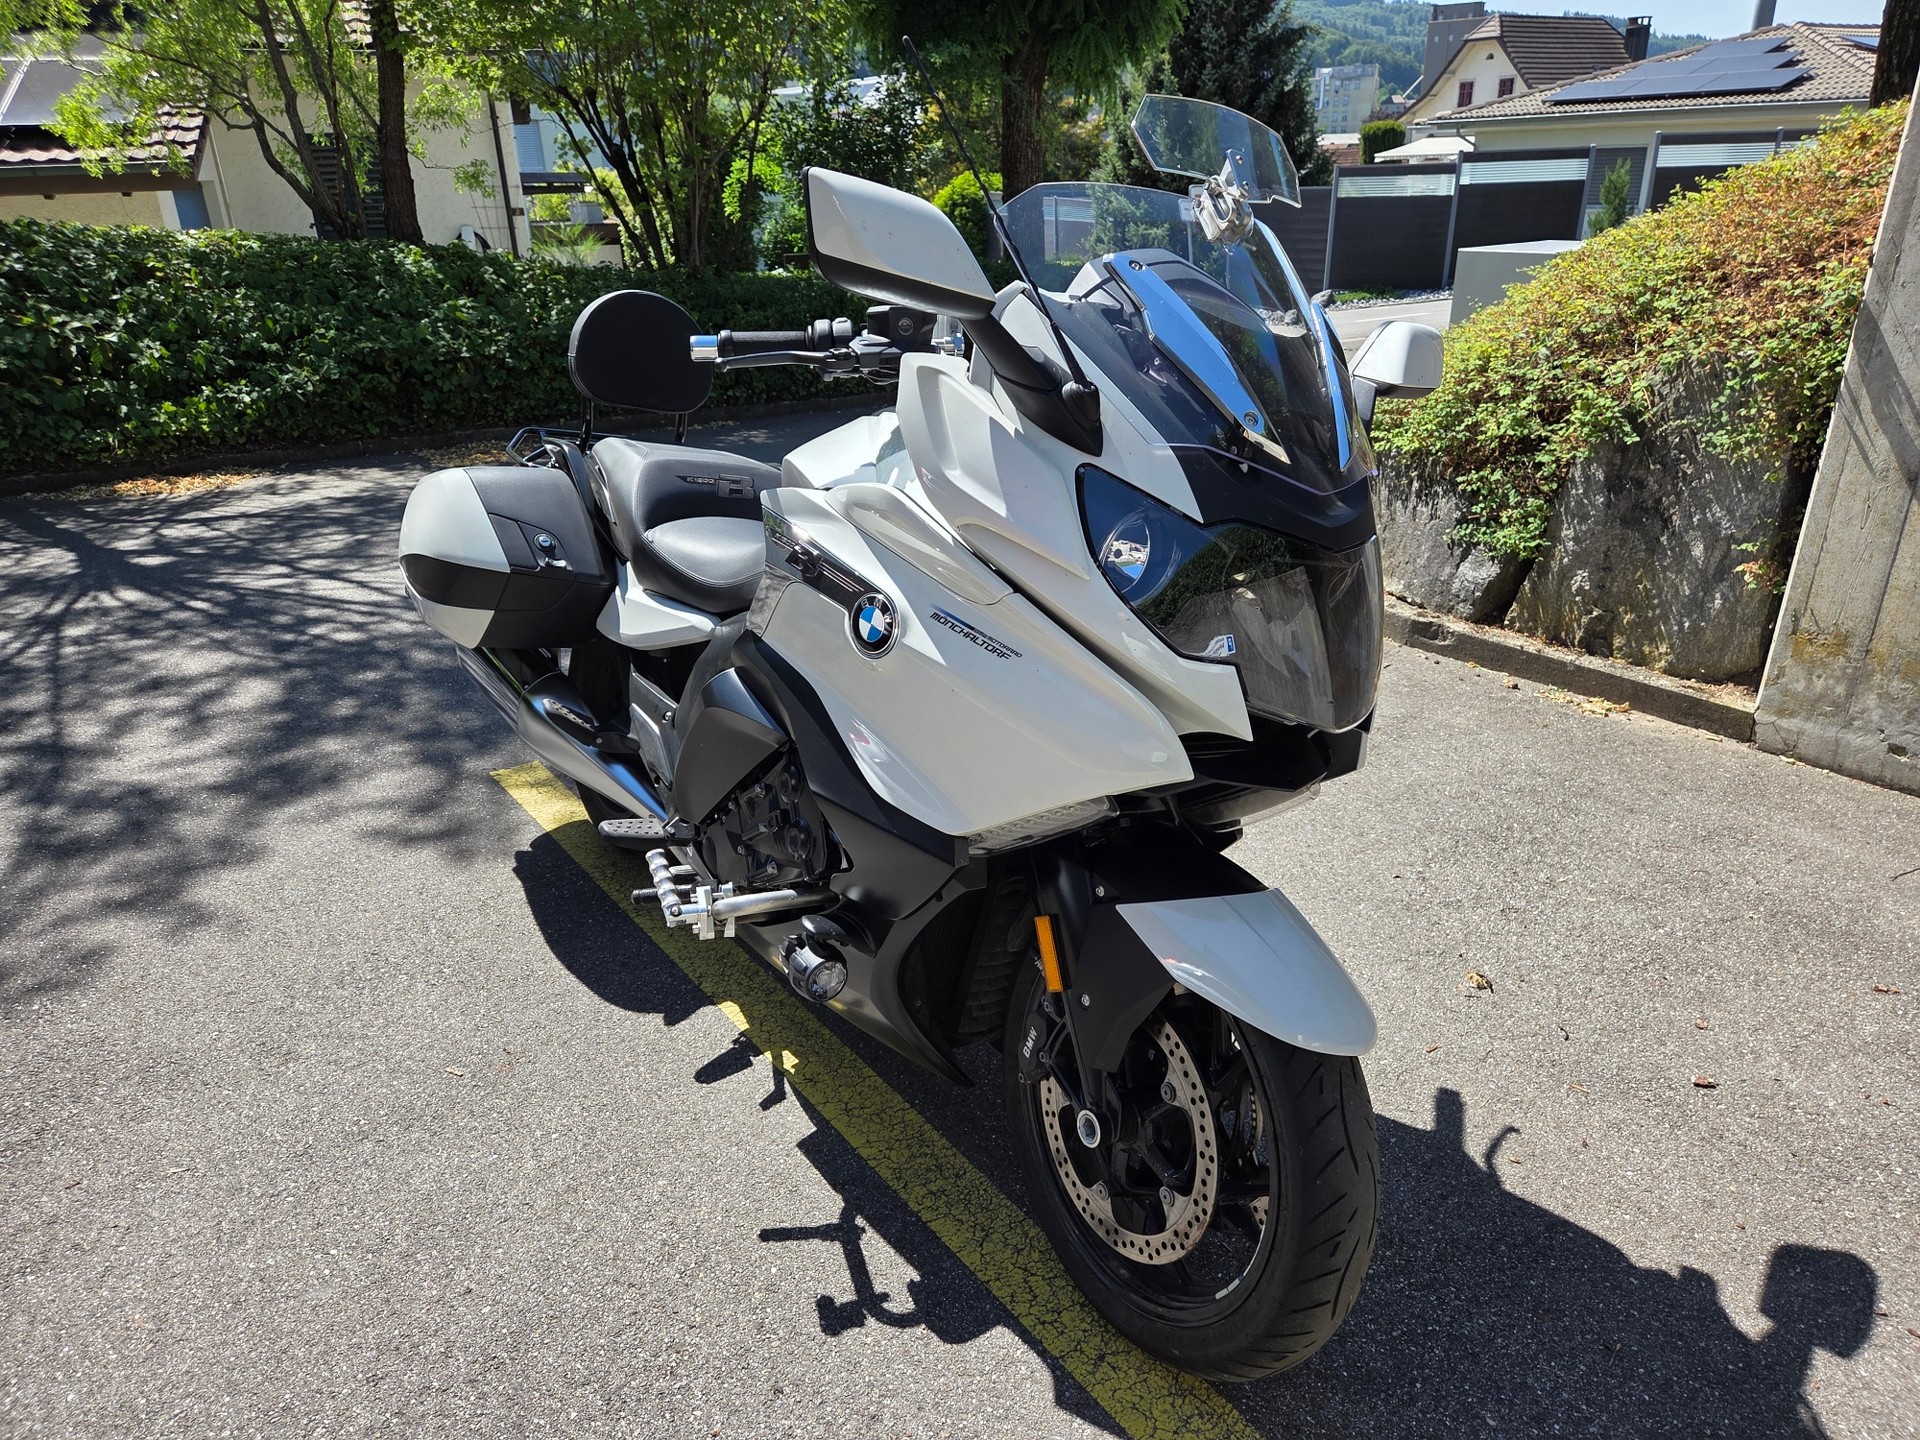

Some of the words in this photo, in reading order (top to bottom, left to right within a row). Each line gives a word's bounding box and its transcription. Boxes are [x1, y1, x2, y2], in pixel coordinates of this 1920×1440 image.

[860, 596, 892, 636] BMW
[929, 611, 1012, 660] MÖNCHALTORF
[986, 635, 1023, 658] MOTORRAD
[1022, 1026, 1038, 1059] BMW
